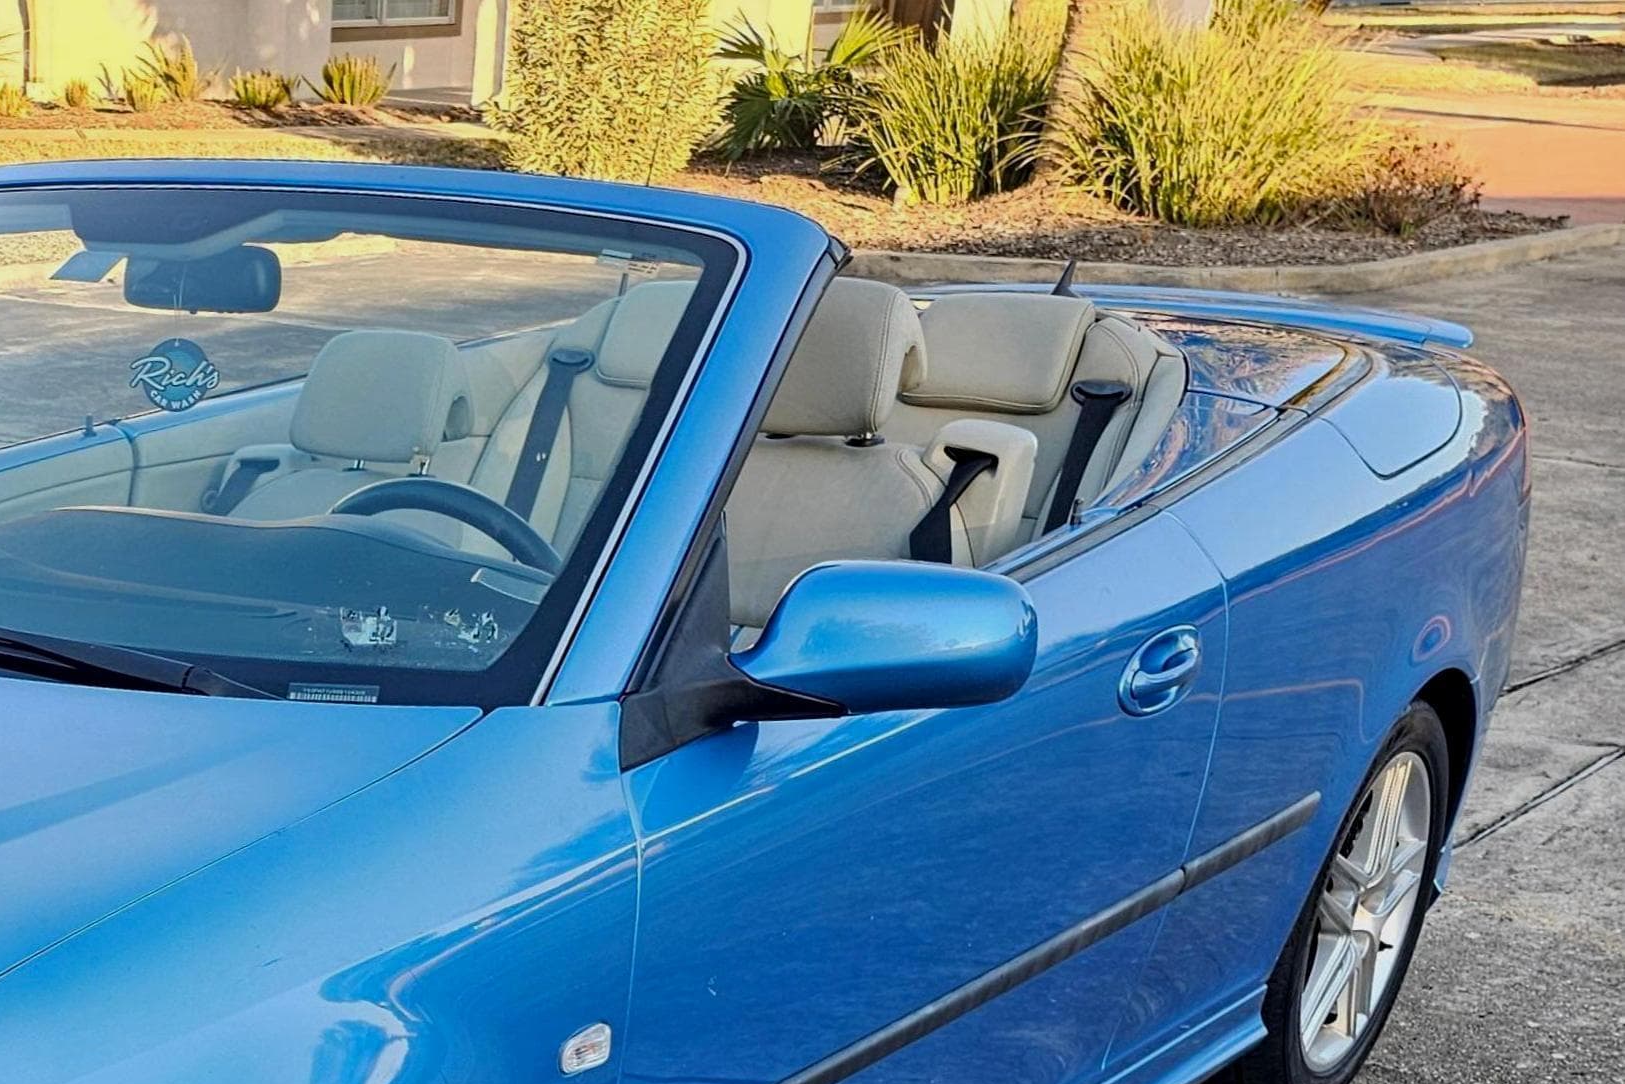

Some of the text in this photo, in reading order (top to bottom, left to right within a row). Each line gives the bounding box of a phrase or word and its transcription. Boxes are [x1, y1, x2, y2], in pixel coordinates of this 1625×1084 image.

[131, 356, 218, 390] Rich's
[150, 389, 201, 409] CAR WASH
